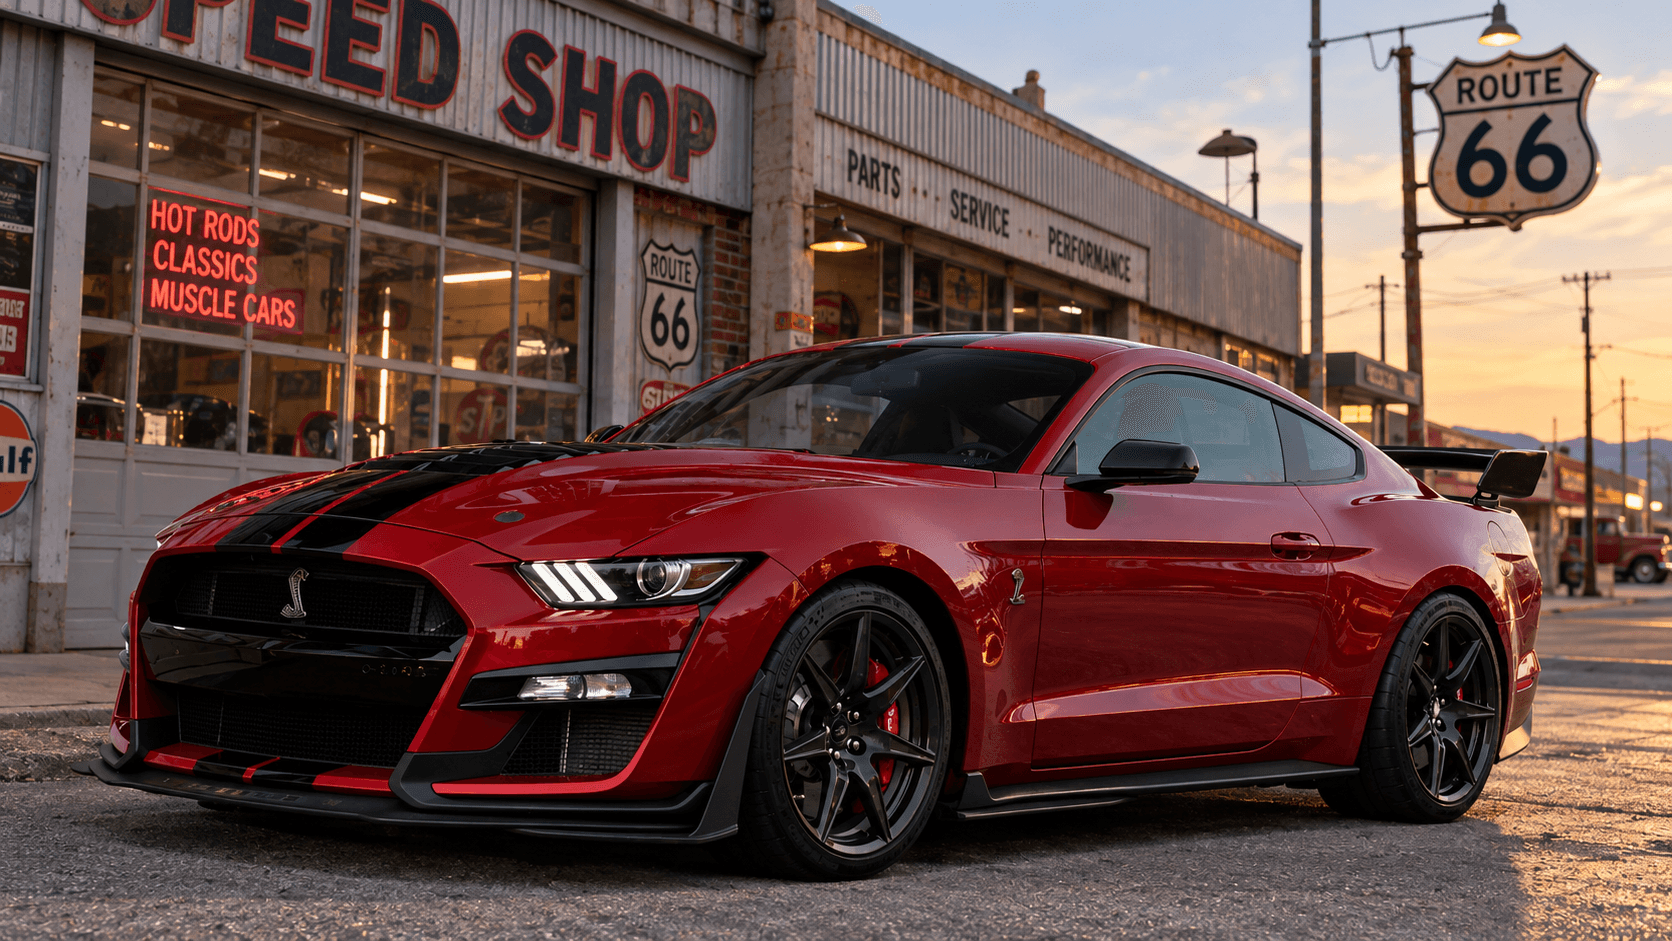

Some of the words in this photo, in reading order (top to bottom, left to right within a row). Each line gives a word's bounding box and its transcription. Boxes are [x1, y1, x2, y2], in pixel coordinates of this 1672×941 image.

[81, 0, 461, 110] EED
[498, 29, 717, 182] SHOP
[1457, 66, 1563, 104] ROUTE
[1456, 112, 1568, 198] 66
[151, 199, 197, 236] HOT
[203, 209, 260, 248] RODS
[847, 148, 901, 199] PARTS
[950, 188, 1010, 239] SERVICE
[1048, 225, 1131, 283] PERFORMANCE
[153, 239, 258, 285] CLASSICS
[651, 252, 691, 284] ROUTE
[150, 278, 237, 319] MUSCLE
[243, 293, 296, 329] CARS
[651, 292, 690, 351] 66
